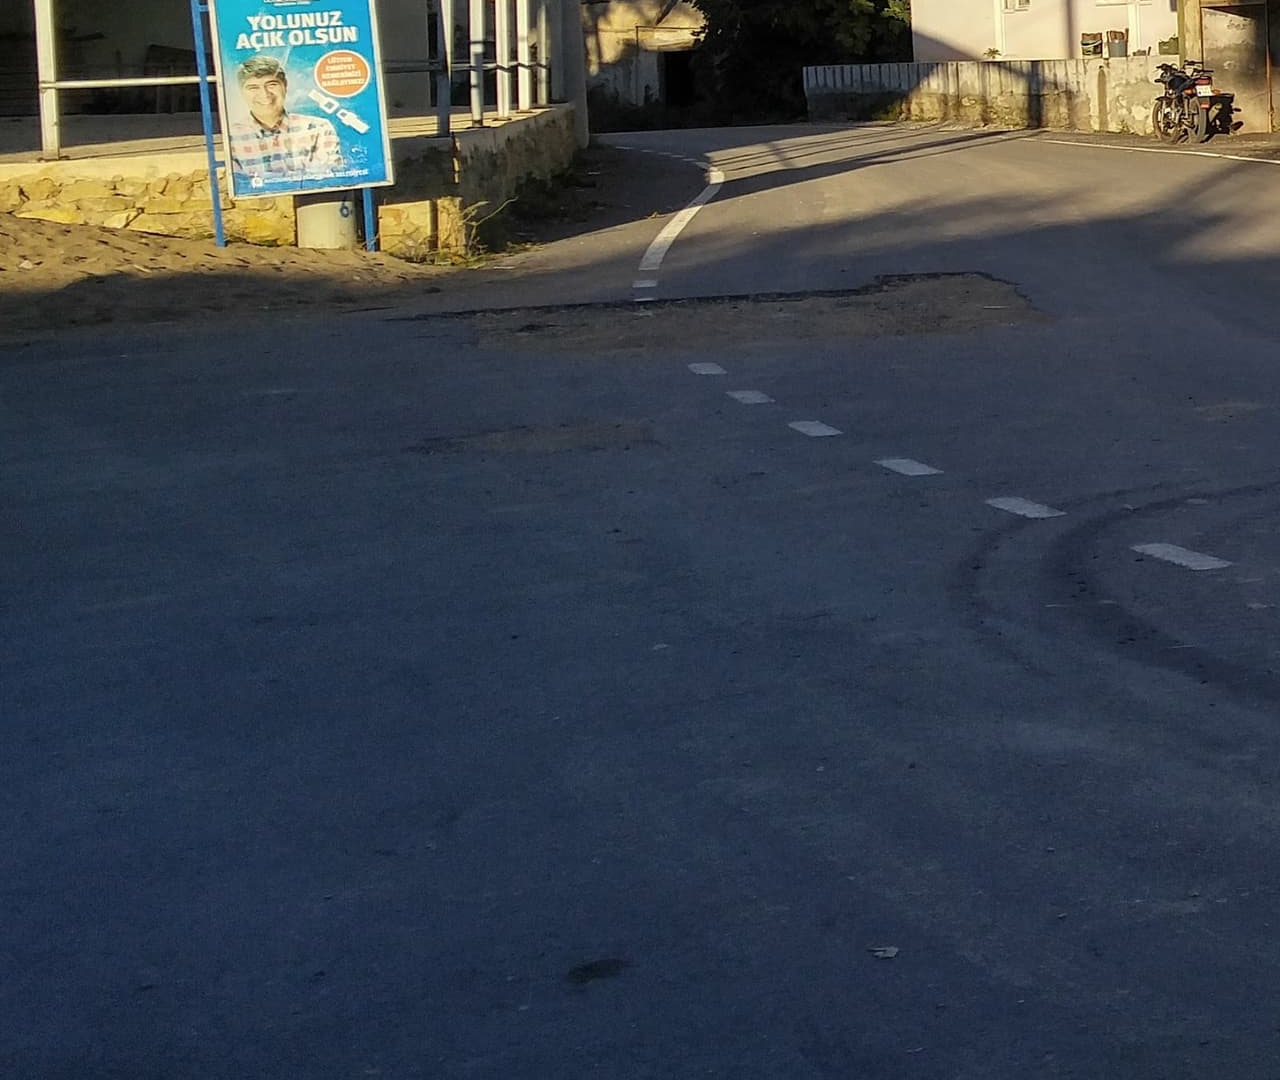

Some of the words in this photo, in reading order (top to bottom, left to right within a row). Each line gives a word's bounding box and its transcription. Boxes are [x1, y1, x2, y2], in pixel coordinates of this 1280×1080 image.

[246, 10, 343, 31] YOLUNUZ
[236, 30, 286, 52] AÇIK
[288, 26, 358, 46] OLSUN
